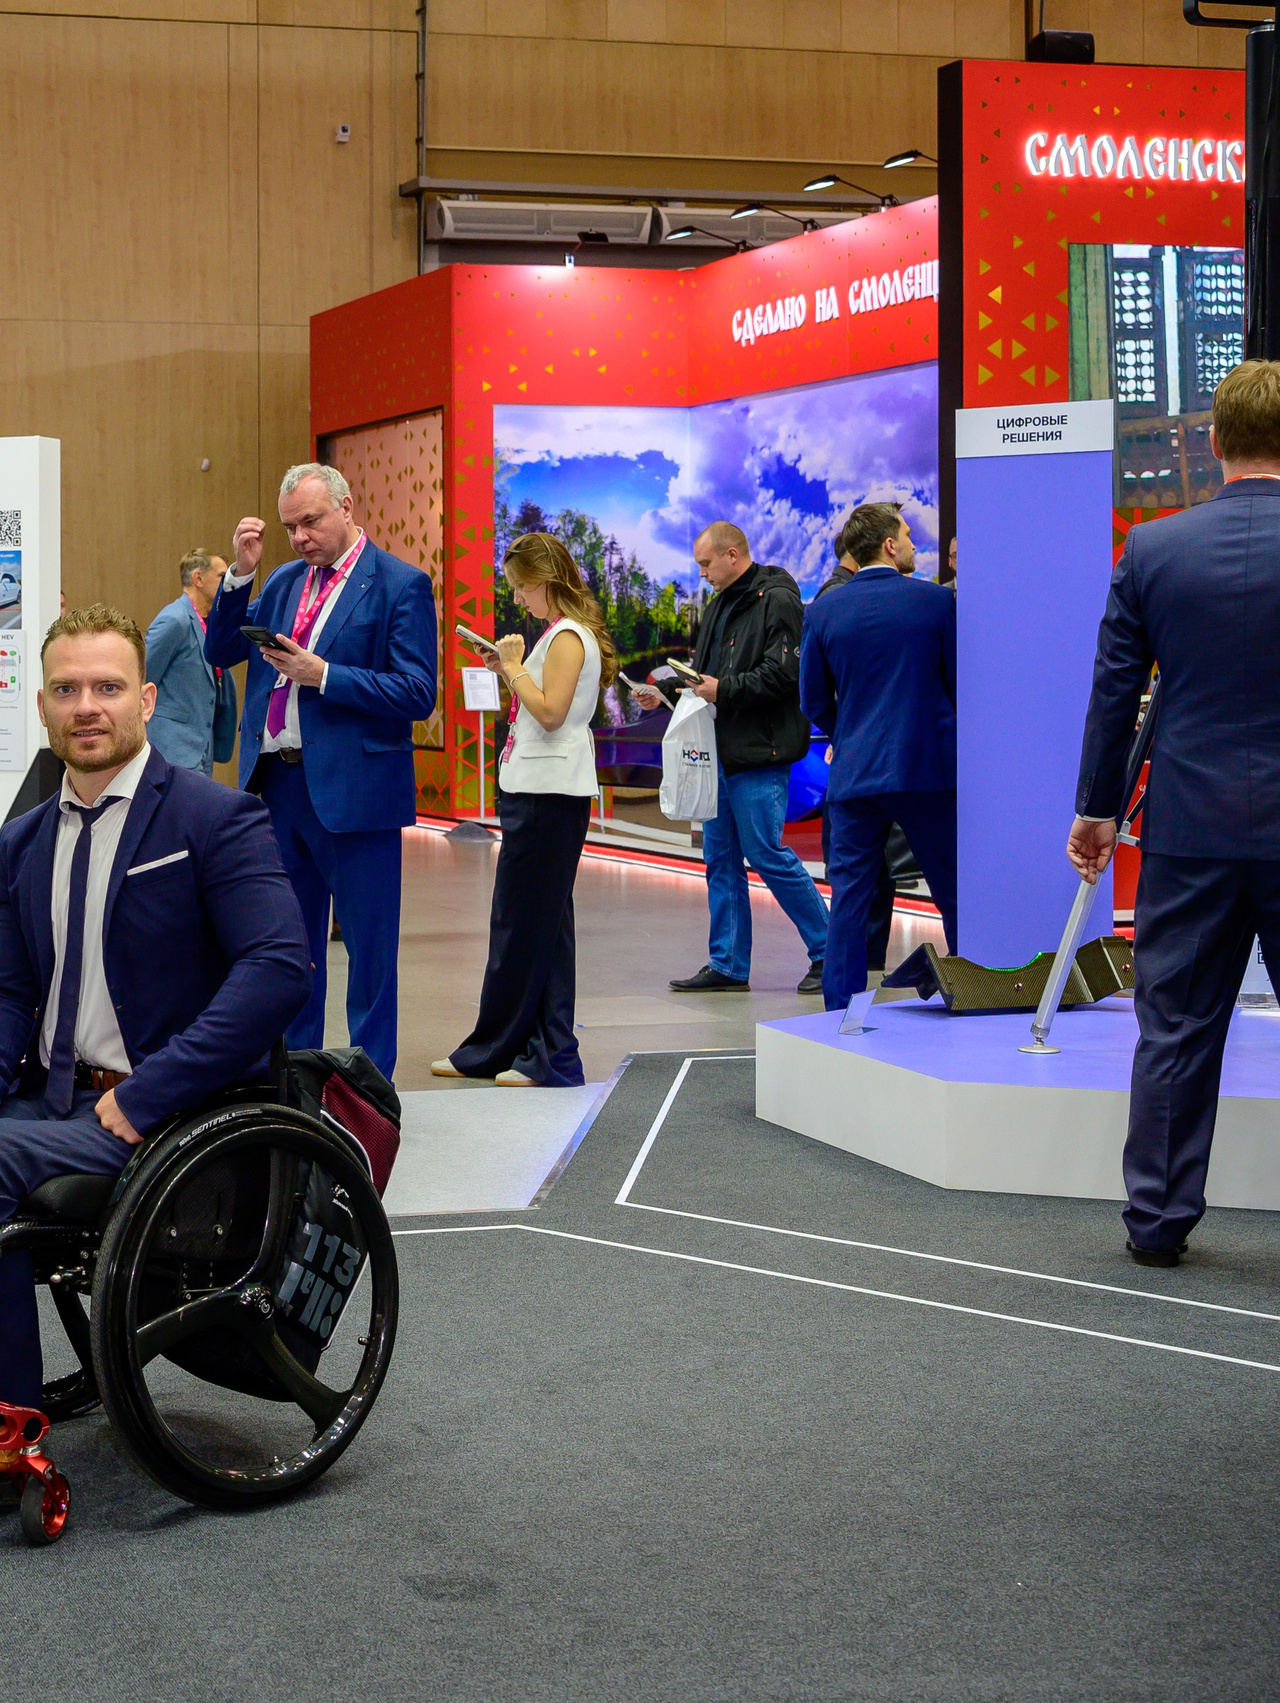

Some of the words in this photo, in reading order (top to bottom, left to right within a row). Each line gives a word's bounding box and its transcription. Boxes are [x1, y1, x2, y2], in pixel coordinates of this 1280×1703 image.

[1024, 131, 1245, 183] СМОЛЕНСК
[732, 293, 807, 348] СДЕЛАНО
[815, 286, 839, 324] НА
[996, 414, 1068, 431] ЦИФРОВЫЕ
[1002, 430, 1062, 444] РЕШЕНИЯ
[191, 1113, 233, 1138] SENTINEL
